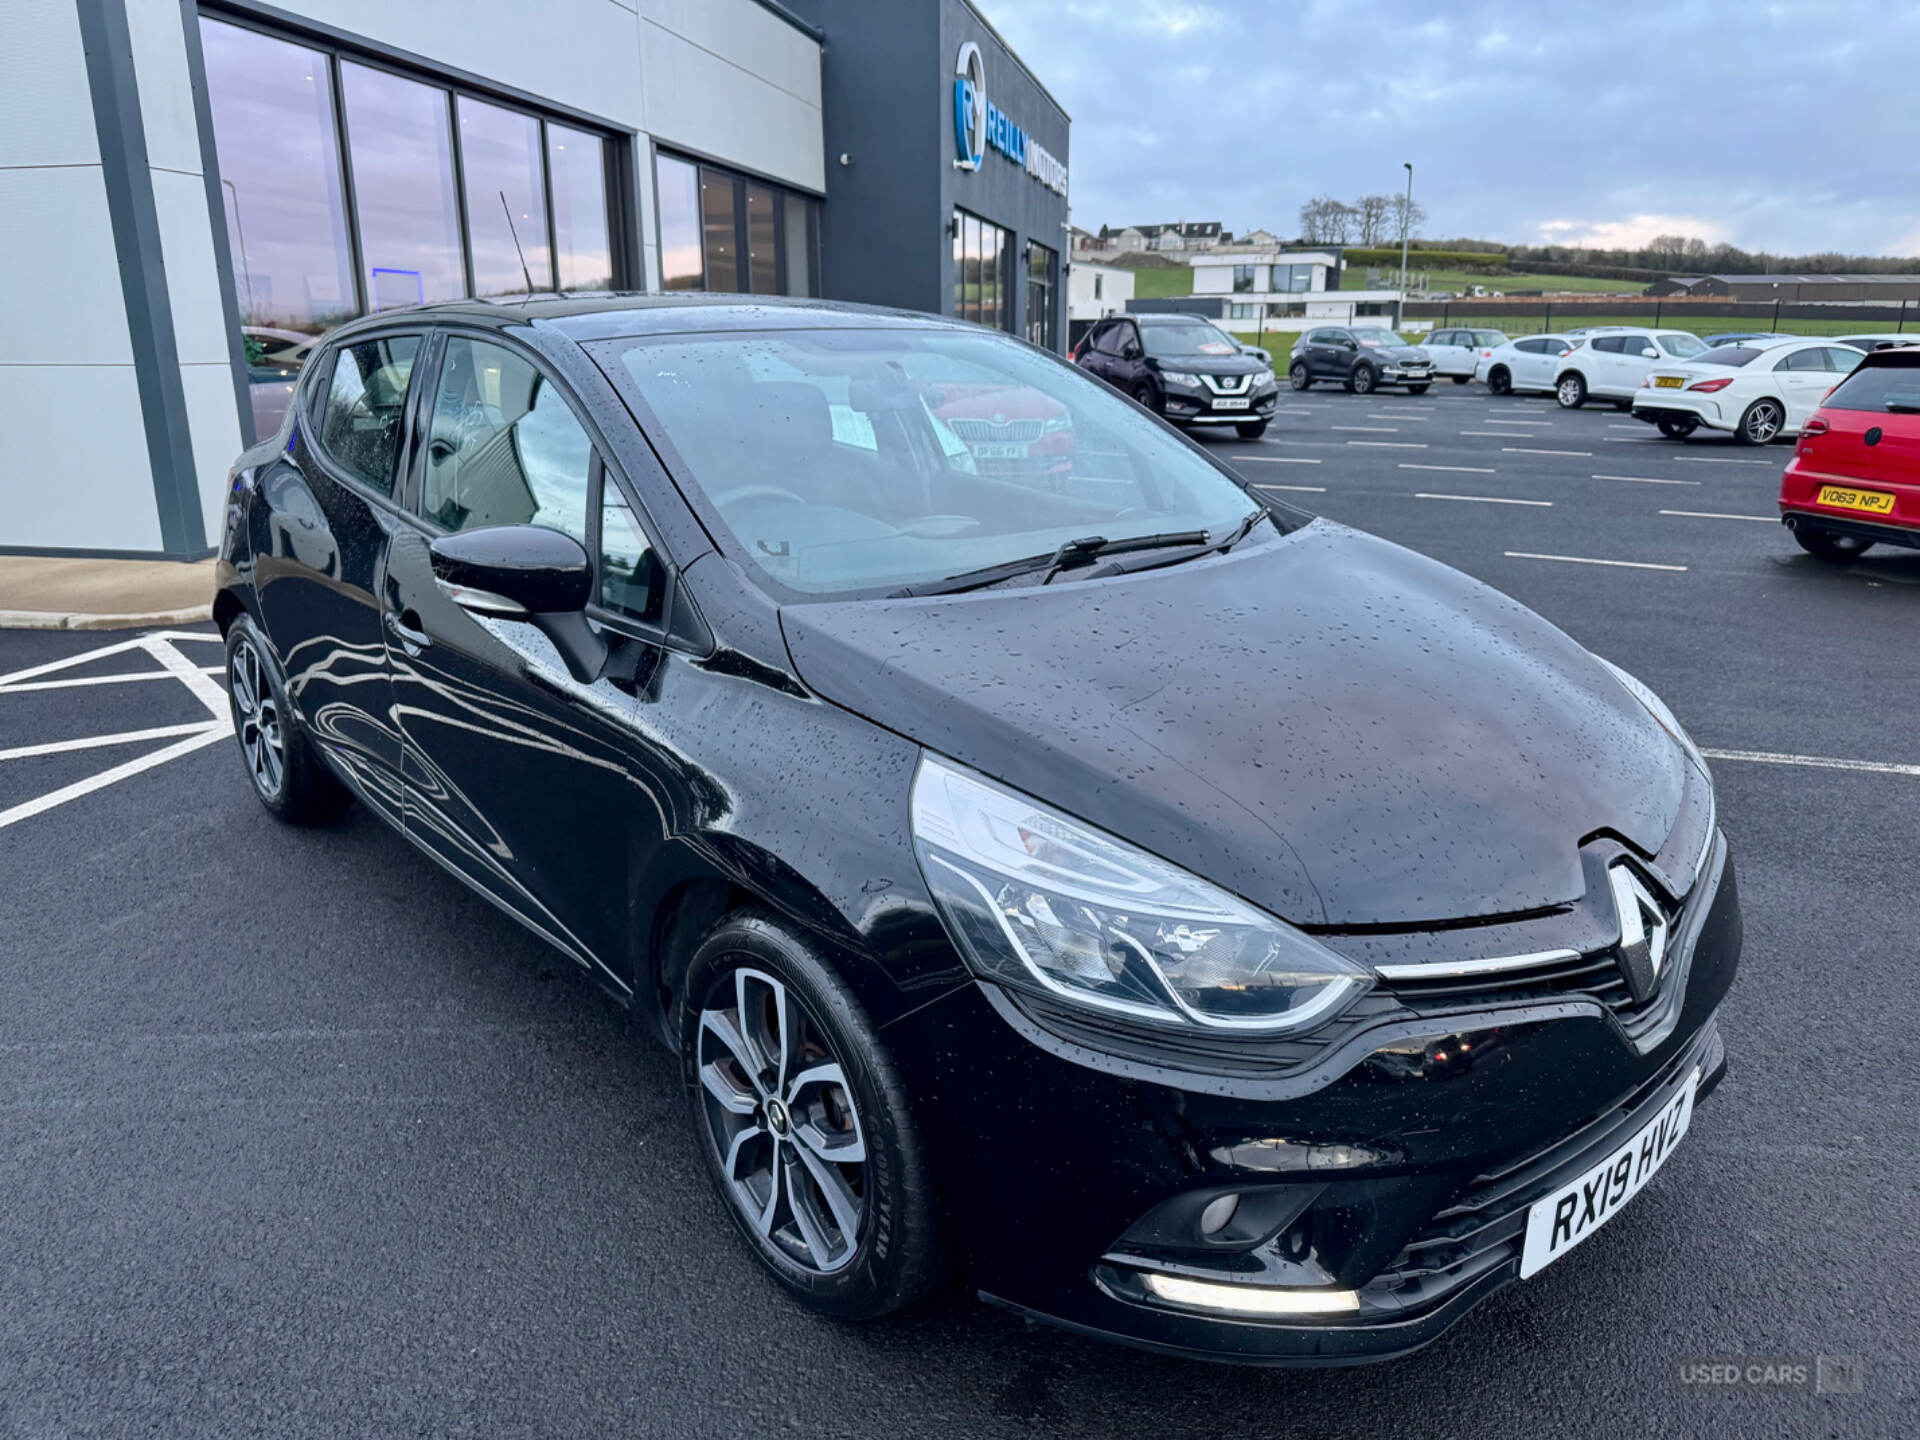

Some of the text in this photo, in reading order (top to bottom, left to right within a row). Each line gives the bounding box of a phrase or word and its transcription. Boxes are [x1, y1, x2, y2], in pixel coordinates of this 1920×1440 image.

[987, 100, 1028, 166] REILLY
[1859, 494, 1890, 509] NPJ
[1549, 1091, 1687, 1252] RX19 HVZ
